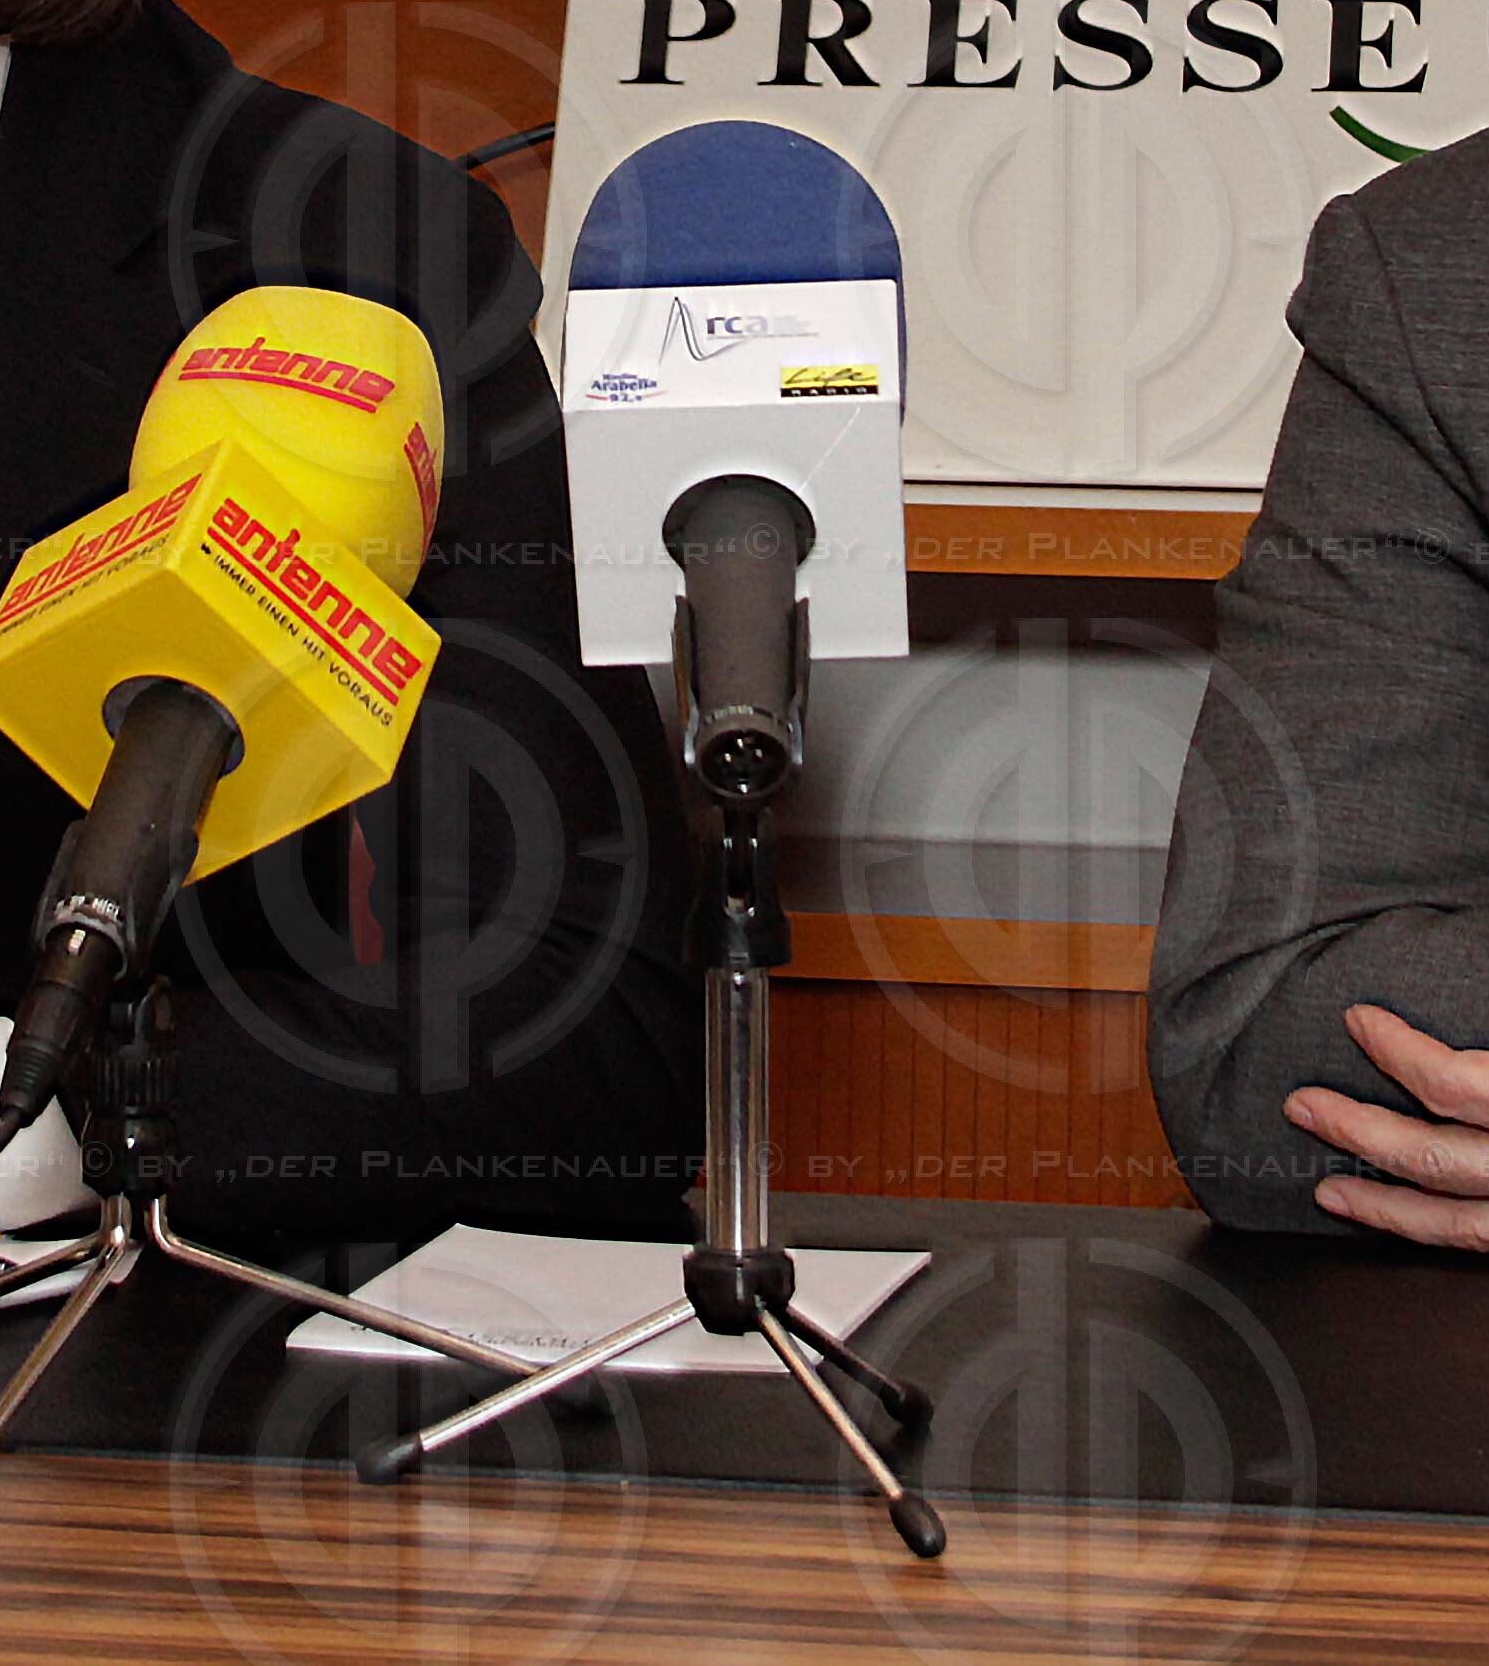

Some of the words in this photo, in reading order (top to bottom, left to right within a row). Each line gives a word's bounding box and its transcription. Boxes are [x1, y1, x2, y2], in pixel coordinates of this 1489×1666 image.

[181, 336, 395, 404] antenne
[212, 497, 423, 691] antenne
[213, 554, 256, 597] IMMER
[328, 661, 394, 727] VORAUS
